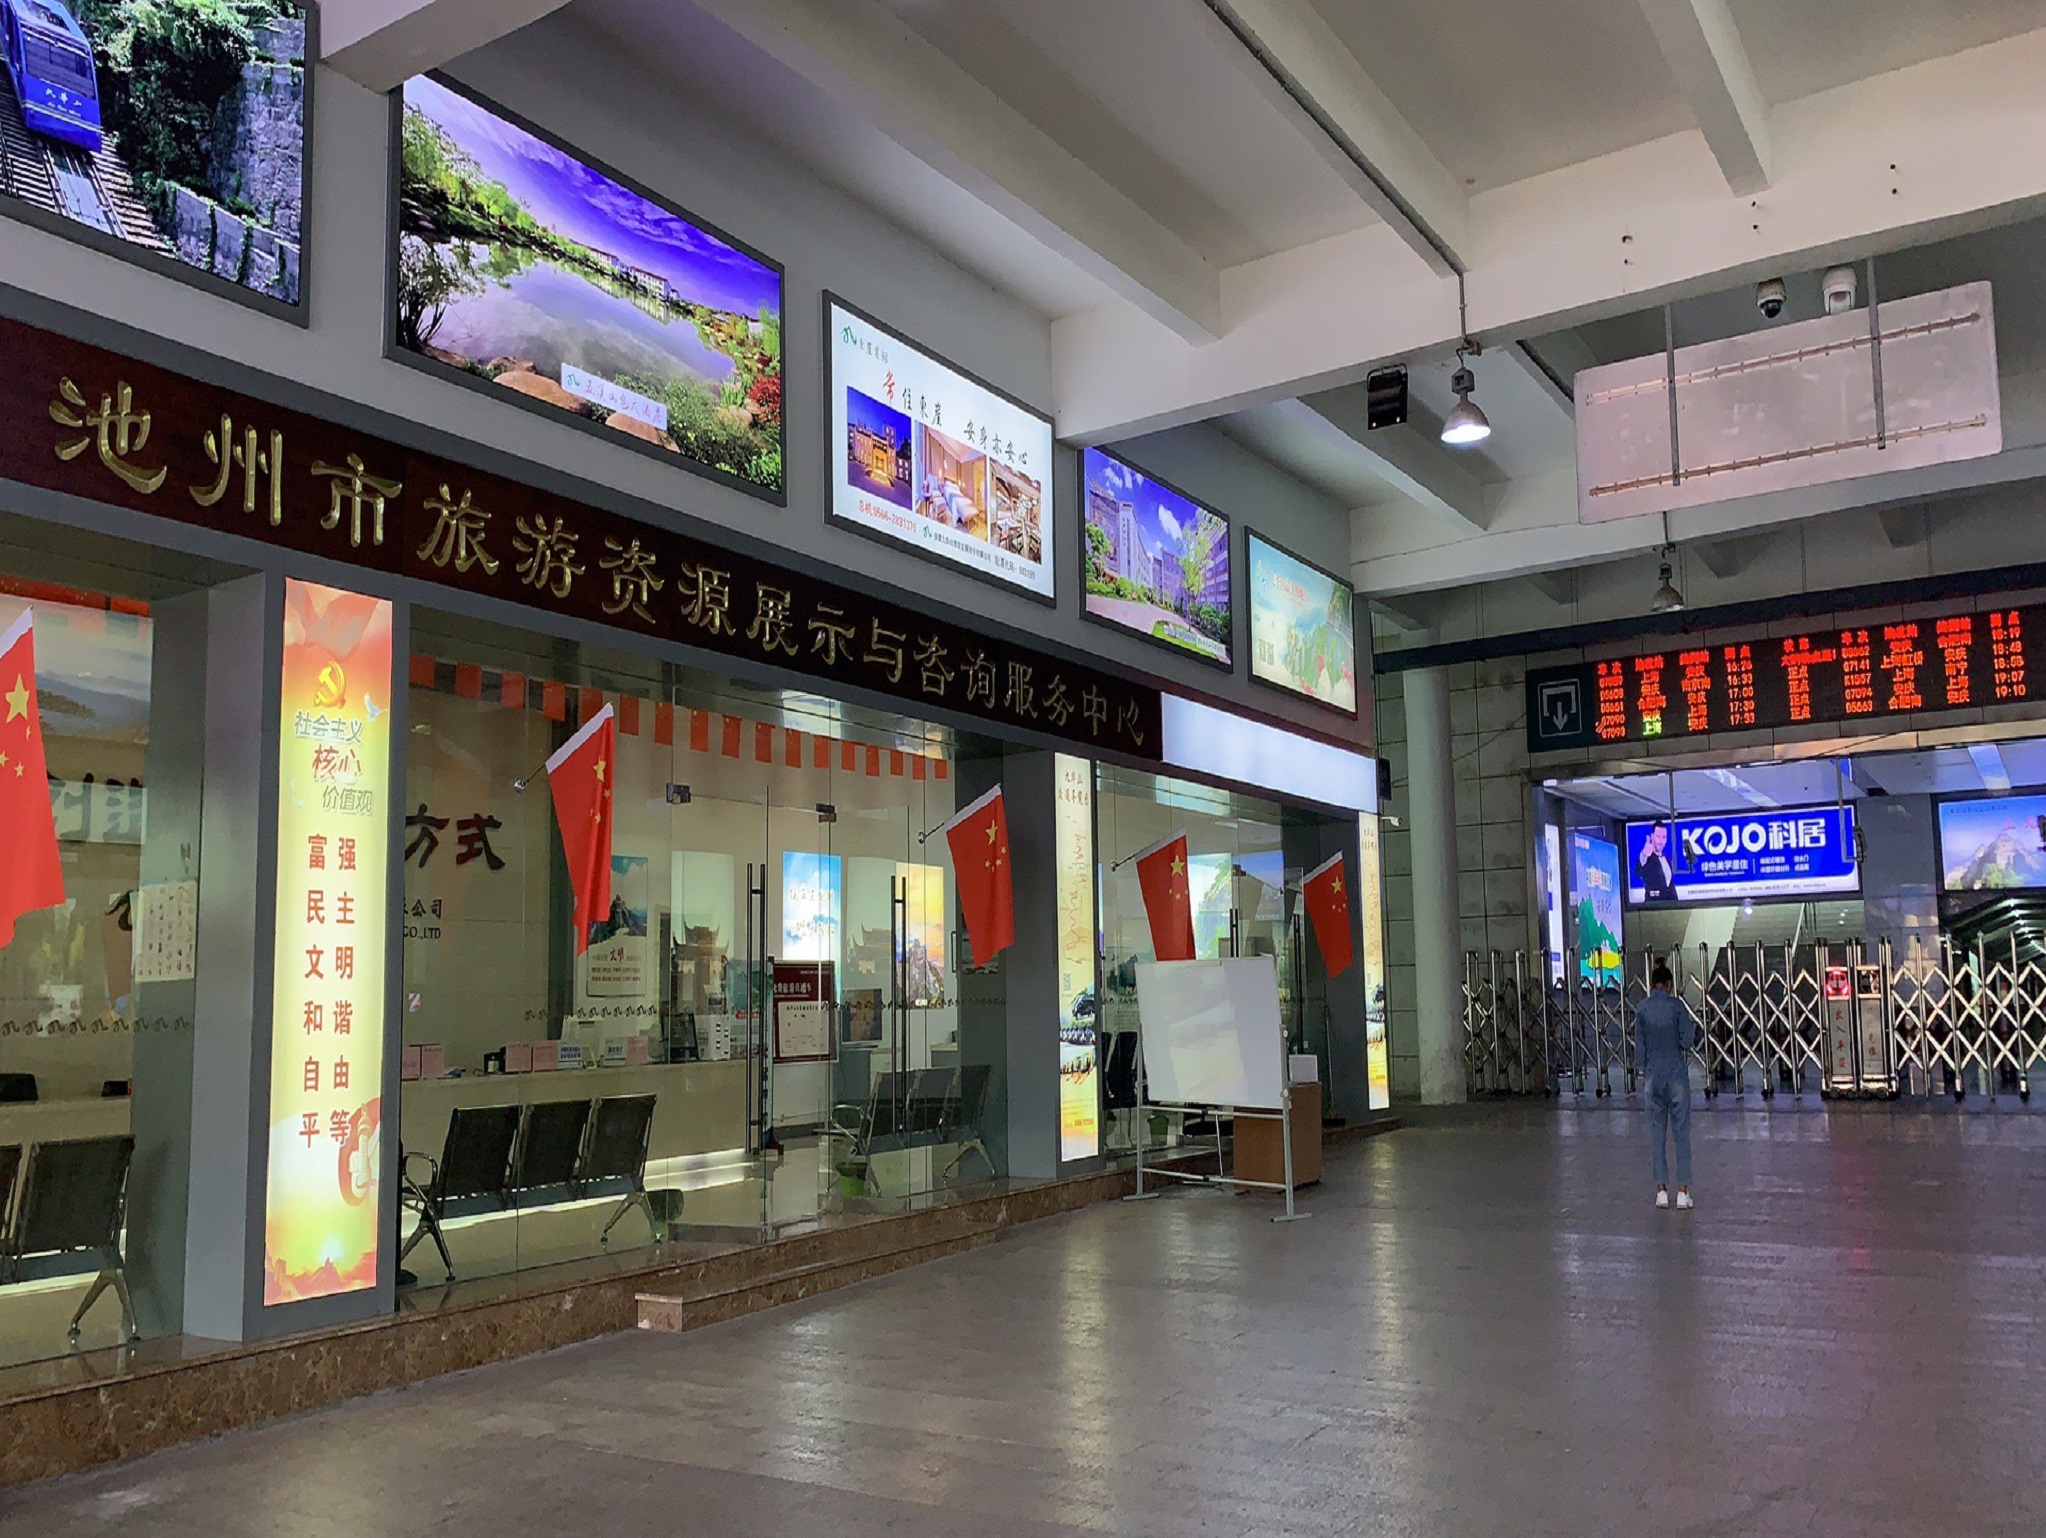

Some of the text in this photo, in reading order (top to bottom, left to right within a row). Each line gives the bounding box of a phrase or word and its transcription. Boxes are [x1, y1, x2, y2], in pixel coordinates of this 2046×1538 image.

[48, 377, 1145, 746] 池州市旅游资源展示与咨询服务中心
[1844, 659, 1870, 672] G7141
[1881, 651, 1923, 668] 上海虹桥
[1945, 647, 1967, 661] 安庆
[1844, 674, 1871, 686] K1557
[1893, 667, 1914, 682] 上海
[1945, 661, 1967, 676] 南宁
[1641, 671, 1660, 684] 上海
[1681, 676, 1710, 691] 南京南
[1788, 666, 1808, 679] 正点
[1894, 681, 1915, 695] 安庆
[1947, 676, 1968, 690] 上海
[1995, 670, 2024, 684] 19:07
[1637, 695, 1666, 710] 合肥南
[1687, 691, 1706, 704] 安庆
[1728, 686, 1754, 699] 17:00
[1789, 680, 1809, 692] 正点
[1688, 705, 1707, 717] 上海
[1729, 700, 1754, 712] 17:30
[1790, 694, 1809, 706] 正点
[1888, 694, 1921, 710] 合肥南
[1947, 689, 1969, 704] 安庆
[1996, 684, 2026, 698] 19:10
[294, 711, 364, 744] 社会主义
[1643, 722, 1662, 736] 上海
[1688, 717, 1708, 731] 安庆
[1791, 706, 1810, 720] 正点
[312, 743, 362, 780] 核心
[322, 784, 373, 815] 价值观
[308, 834, 356, 870] 富强
[405, 803, 506, 870] 方式
[307, 889, 355, 925] 民主
[305, 944, 354, 980] 文明
[303, 999, 353, 1036] 和谐
[304, 1054, 349, 1092] 自由
[299, 1109, 352, 1148] 平等
